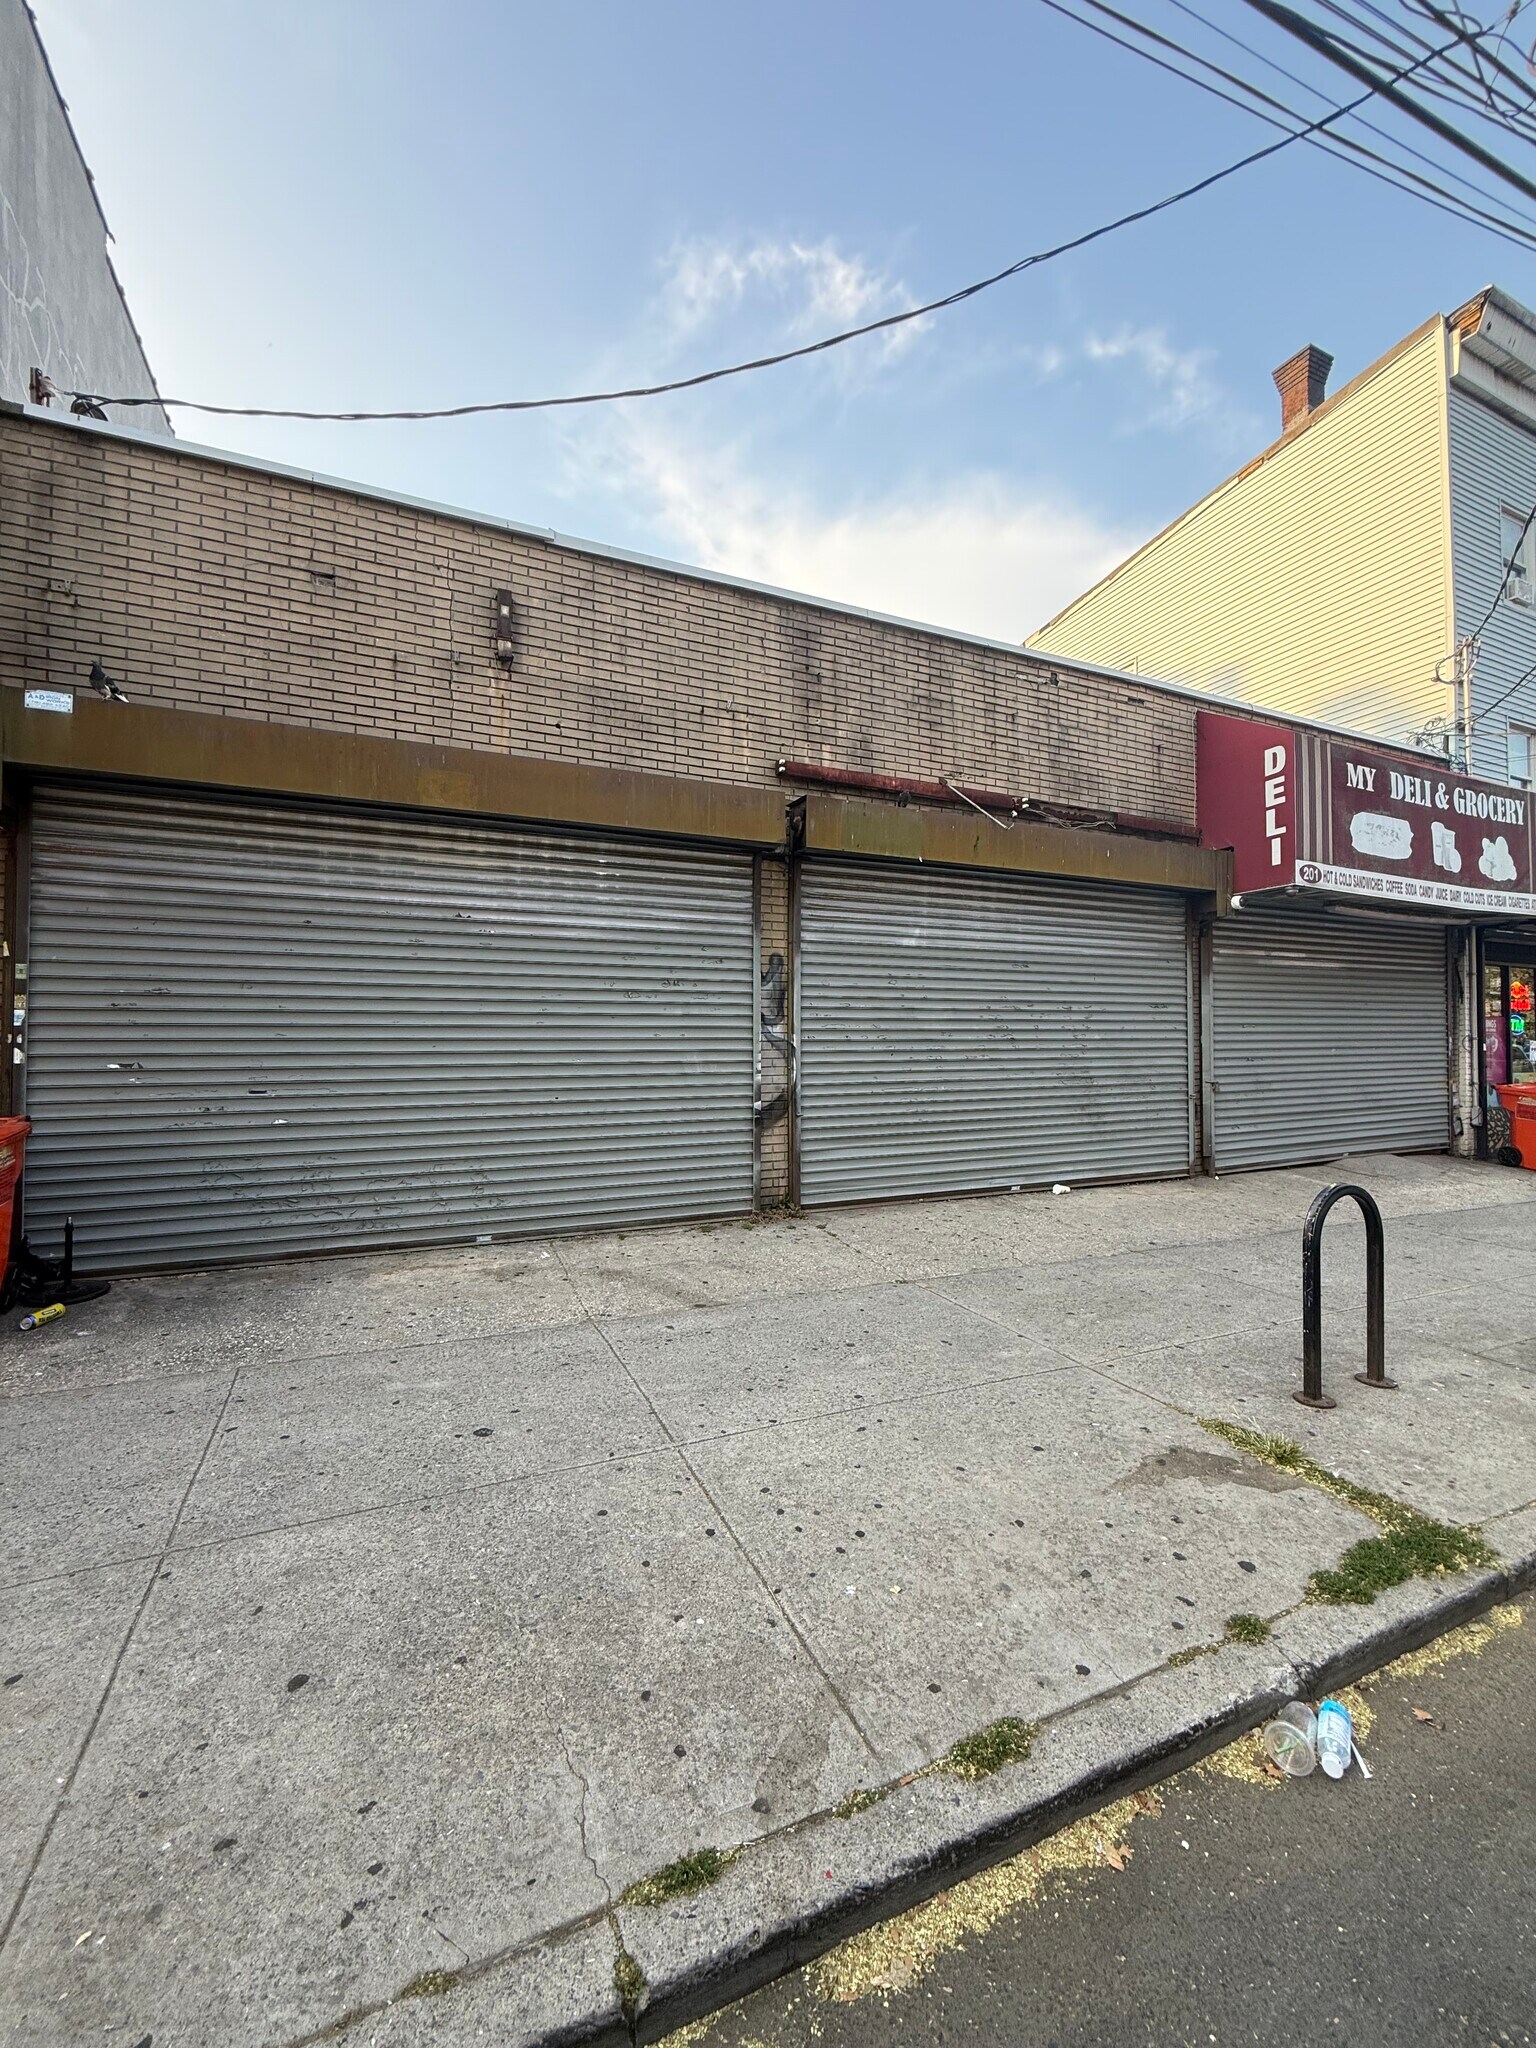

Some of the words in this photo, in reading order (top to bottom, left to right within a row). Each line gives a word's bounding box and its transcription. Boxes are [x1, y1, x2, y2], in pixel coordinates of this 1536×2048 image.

[1264, 745, 1286, 866] DELI
[1346, 762, 1377, 792] MY
[1390, 771, 1432, 808] DELI
[1434, 782, 1450, 810] &
[1453, 787, 1525, 826] GROCERY
[1303, 867, 1319, 882] 201
[1323, 869, 1333, 885] HOT
[1339, 872, 1352, 887] COLD
[1353, 874, 1383, 892] SANDWICHES
[1386, 879, 1403, 895] COFFEE
[1404, 883, 1417, 896] SODA
[1419, 885, 1434, 899] CANDY
[1436, 888, 1448, 900] JUICE
[1450, 889, 1462, 902] DAIRY
[1463, 891, 1474, 904] COLD
[1475, 892, 1486, 906] CUTS
